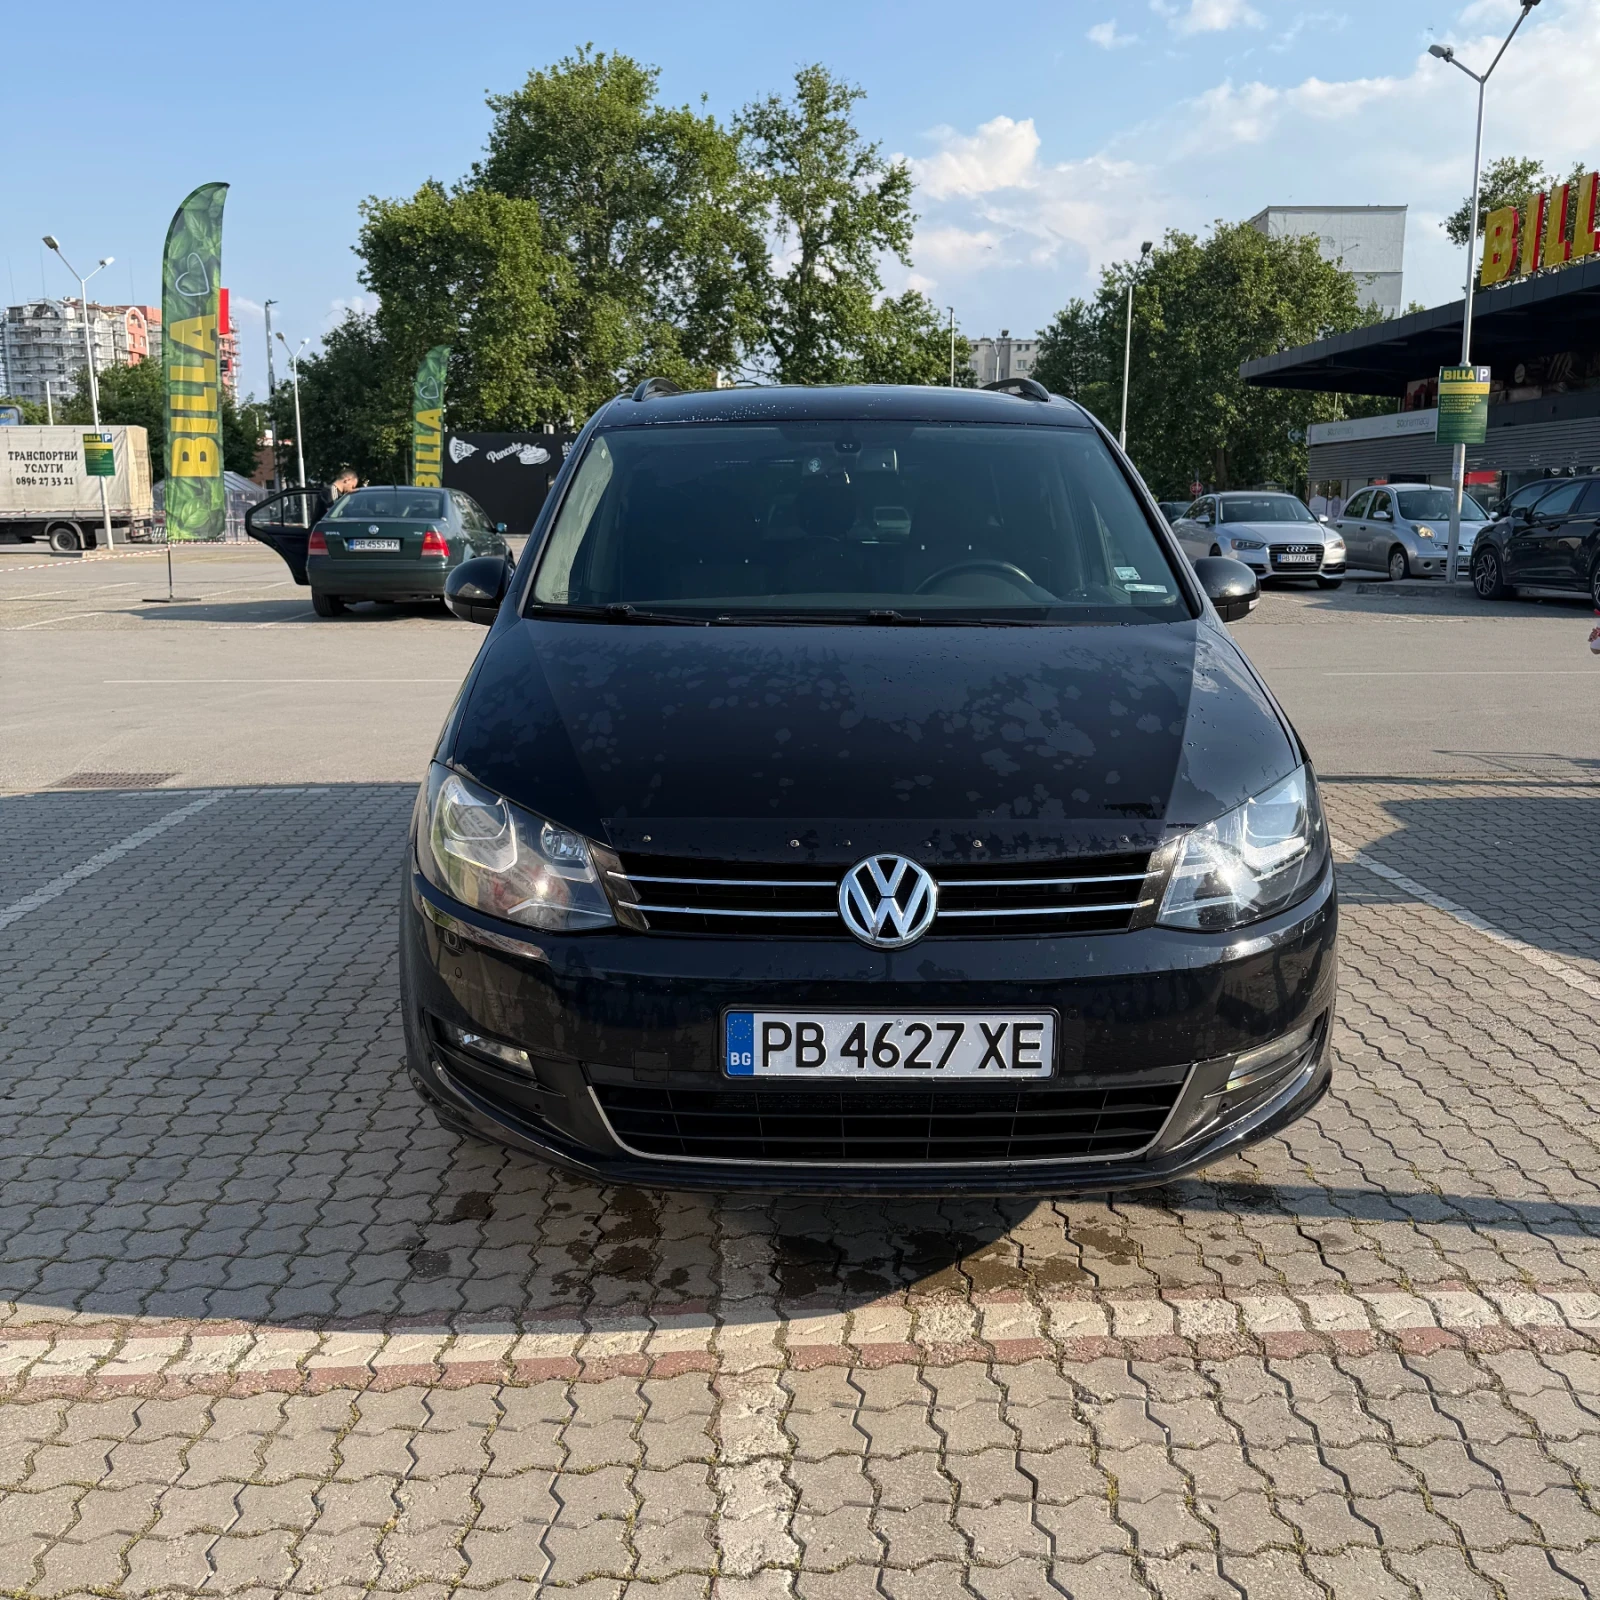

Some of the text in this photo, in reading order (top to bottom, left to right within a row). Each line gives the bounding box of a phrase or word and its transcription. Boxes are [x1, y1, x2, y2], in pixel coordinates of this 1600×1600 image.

[1443, 369, 1475, 380] BILLA
[170, 313, 221, 477] BILLA
[8, 450, 78, 461] ТРАНСПОРТНИ
[416, 408, 442, 487] BILLA
[486, 441, 524, 464] Pancake
[24, 463, 63, 474] УСЛУГИ
[16, 476, 74, 487] 0896 27 33 21
[762, 1021, 1044, 1070] PB 4627 XE
[730, 1051, 752, 1067] BG
